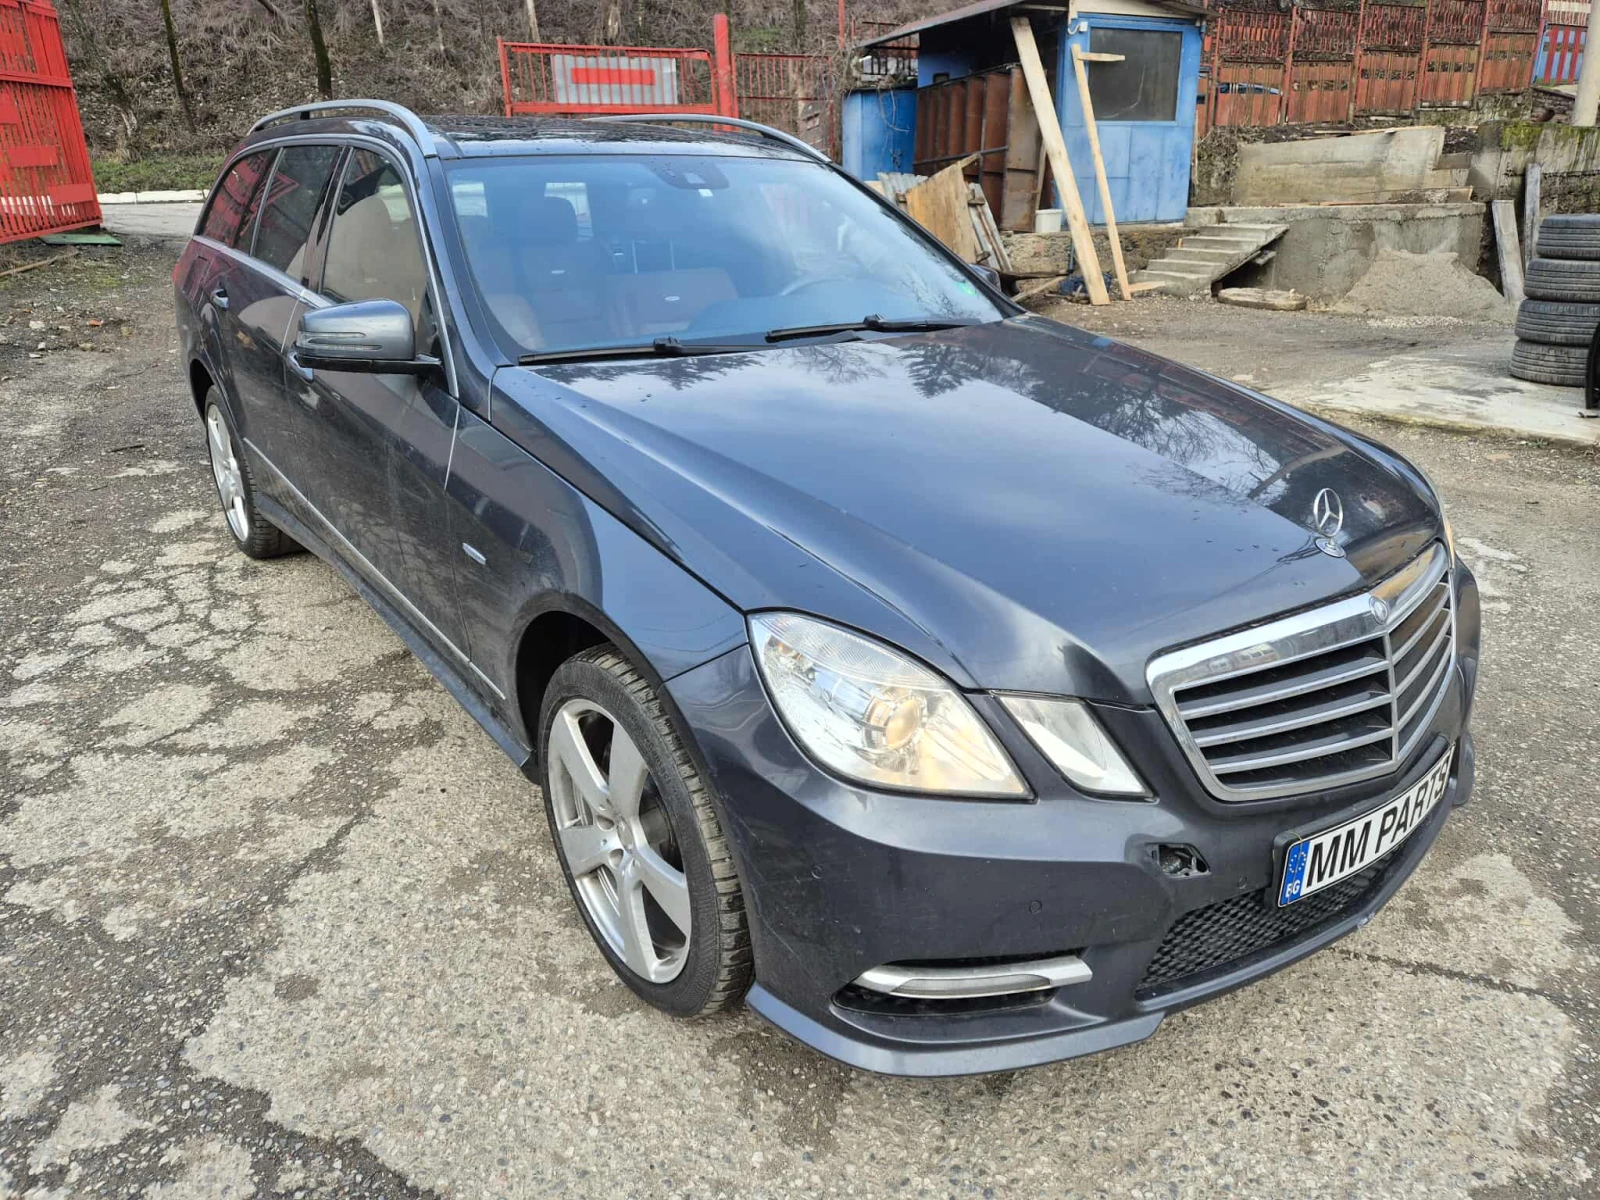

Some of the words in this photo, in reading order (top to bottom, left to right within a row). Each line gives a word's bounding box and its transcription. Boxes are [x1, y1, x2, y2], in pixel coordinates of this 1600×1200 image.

[1306, 821, 1371, 888] MM
[1375, 756, 1449, 854] PARTS
[1285, 881, 1300, 897] BG
